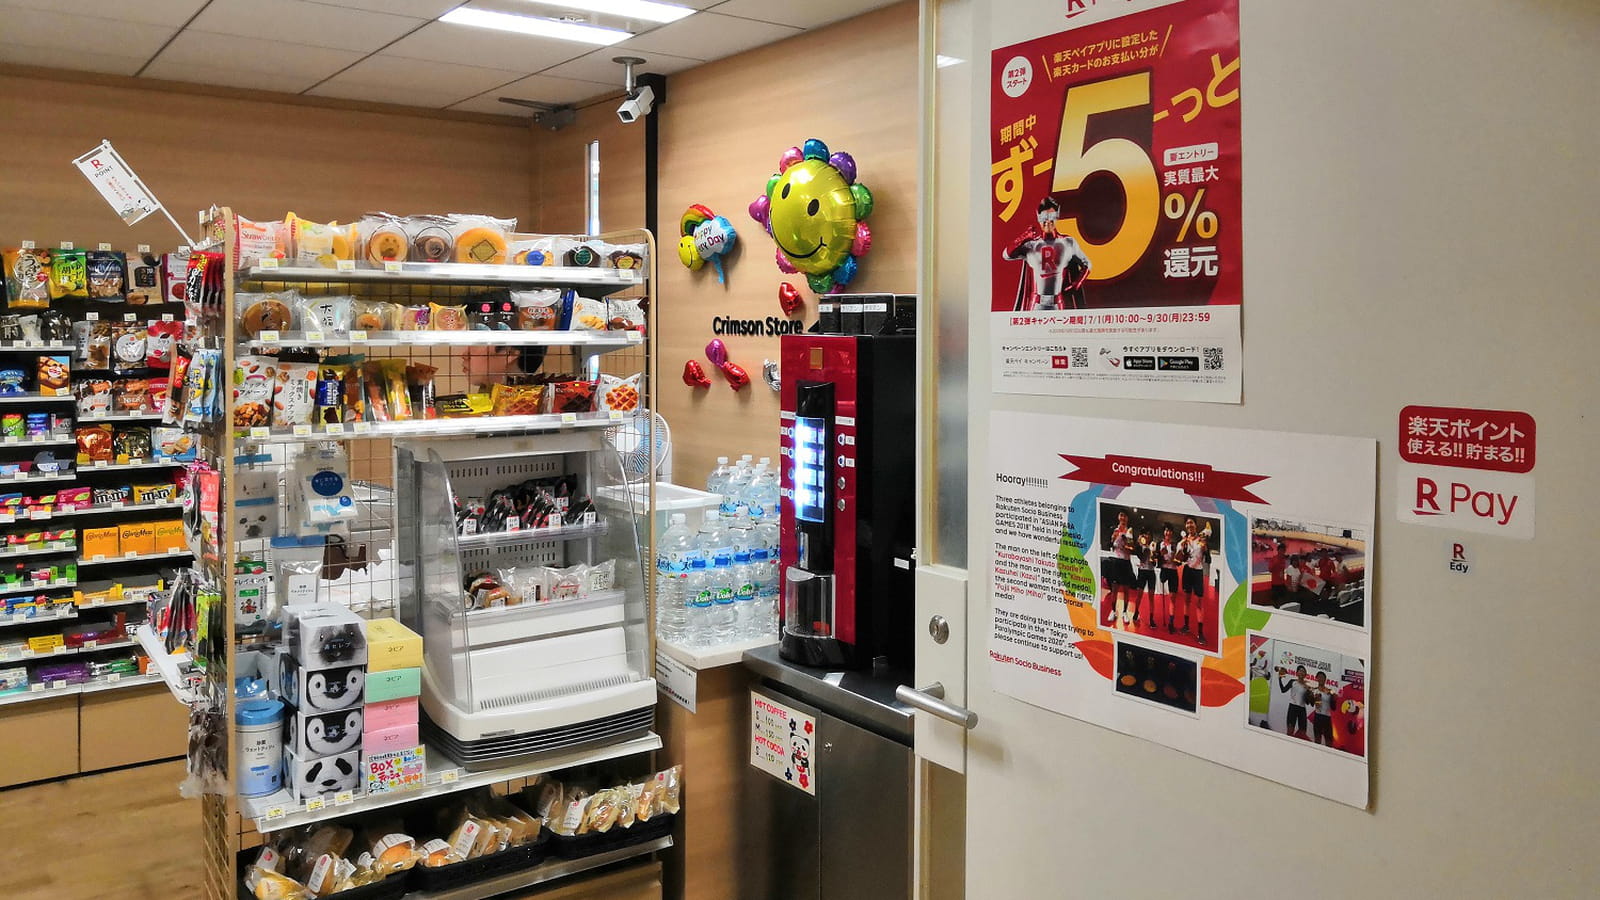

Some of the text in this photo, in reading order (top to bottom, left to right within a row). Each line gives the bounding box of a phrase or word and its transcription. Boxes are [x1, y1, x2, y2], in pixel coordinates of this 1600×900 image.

[1053, 30, 1158, 63] 楽天ペイアプリに設定した
[1053, 45, 1159, 78] 楽天カードのお支払い分が
[1006, 78, 1027, 89] スタート
[1000, 114, 1037, 145] 期間中
[91, 159, 104, 169] R
[94, 165, 113, 178] POINT
[1052, 71, 1160, 280] 5
[1164, 165, 1219, 186] 実質最大
[1165, 188, 1218, 242] %
[707, 234, 725, 247] Day
[1164, 246, 1218, 278] 還元
[320, 304, 333, 326] 大福
[713, 316, 804, 336] Crimson Store
[1408, 416, 1525, 443] 楽天ポイント
[1112, 462, 1205, 483] Congratulations!!!
[1450, 482, 1518, 525] Pay
[1453, 544, 1466, 559] R
[1449, 562, 1468, 573] Edy
[754, 698, 766, 710] HOT
[766, 704, 788, 720] COFFEE
[754, 734, 766, 746] HOT
[370, 759, 394, 774] BOX
